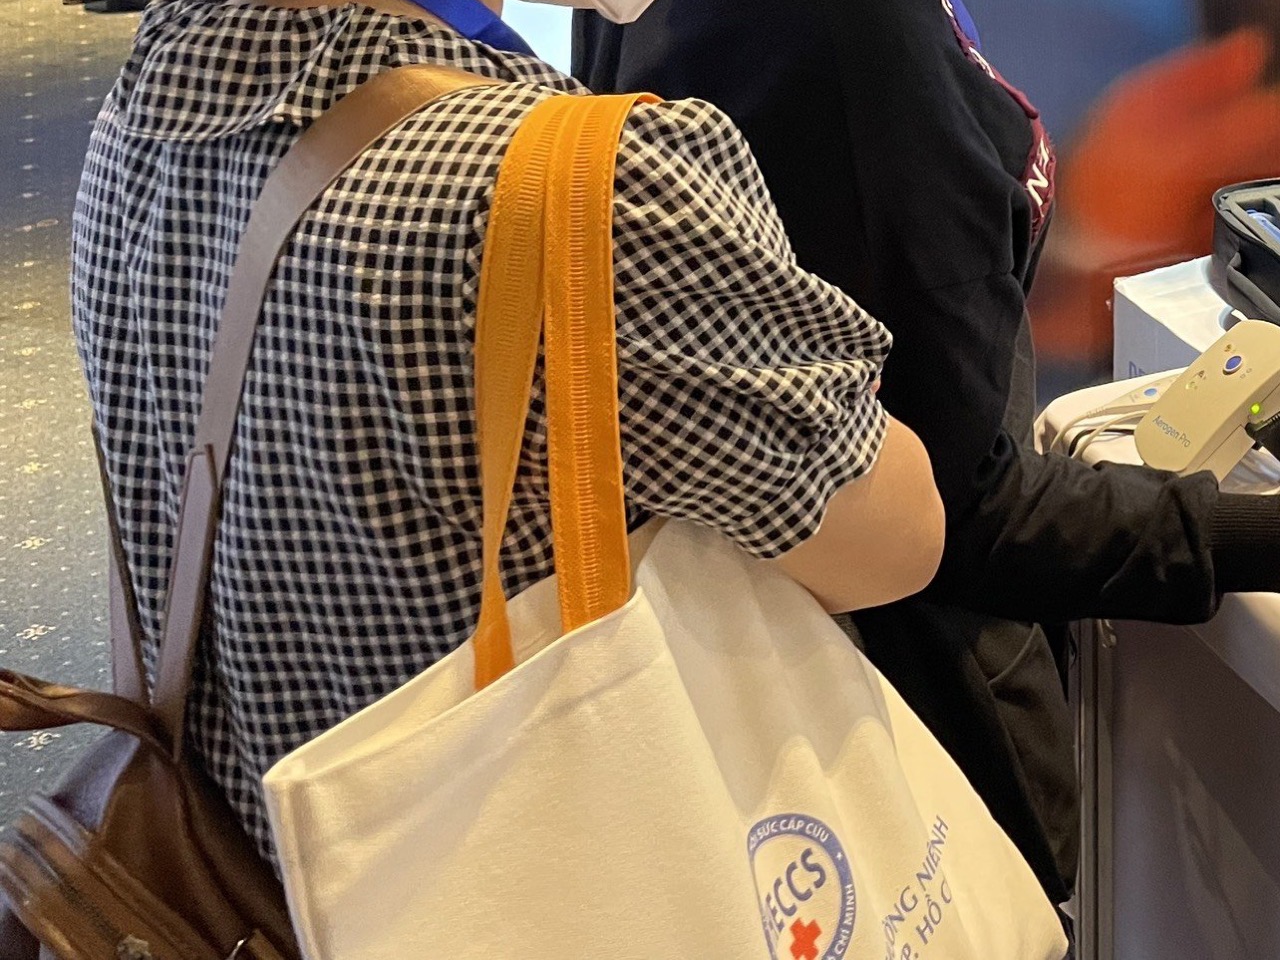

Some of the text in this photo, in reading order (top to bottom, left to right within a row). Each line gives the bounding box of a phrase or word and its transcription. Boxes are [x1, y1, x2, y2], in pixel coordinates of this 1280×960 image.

[1152, 415, 1191, 448] Aerogen Pro
[764, 847, 827, 936] ECCS
